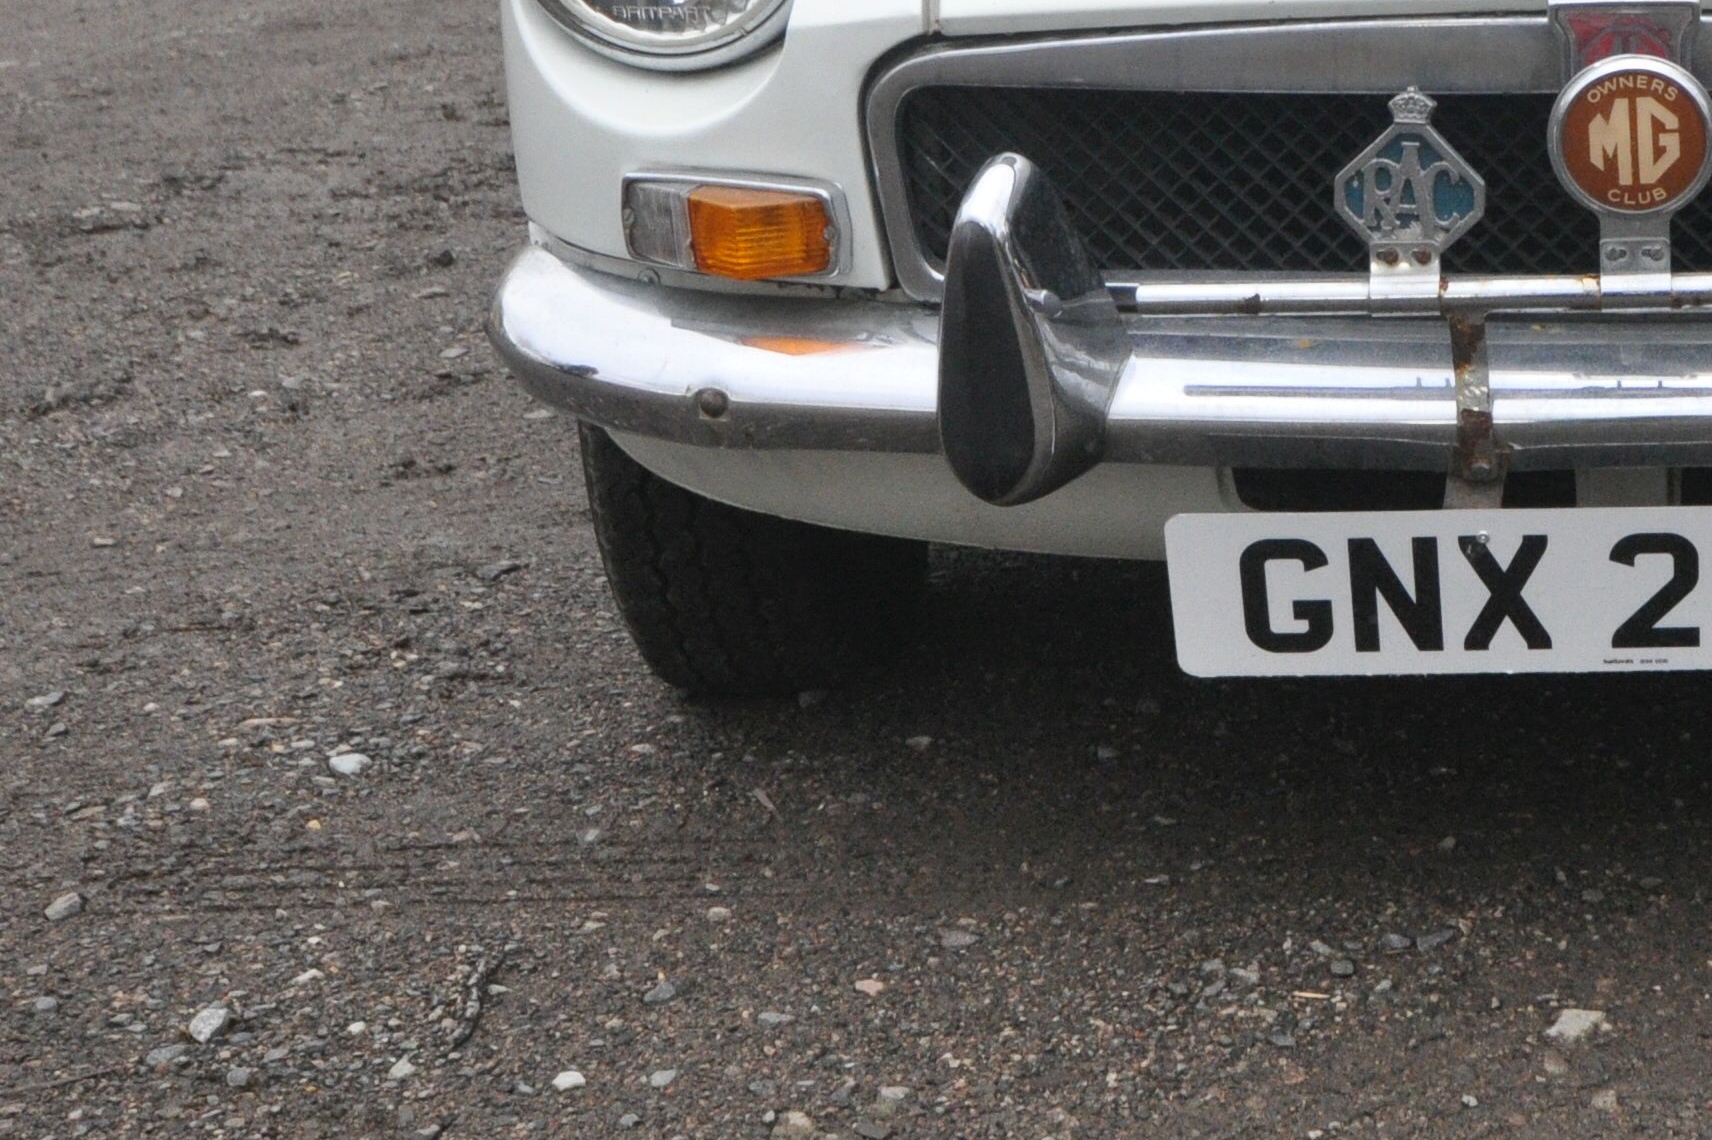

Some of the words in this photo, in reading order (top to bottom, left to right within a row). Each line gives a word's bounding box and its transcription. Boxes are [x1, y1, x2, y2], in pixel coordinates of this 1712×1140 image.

[612, 5, 711, 23] BRITPART
[1587, 74, 1679, 104] OWNERS
[1587, 96, 1681, 186] MG
[1361, 141, 1461, 238] RAC
[1607, 187, 1668, 205] CLUB
[1239, 534, 1553, 654] GNX
